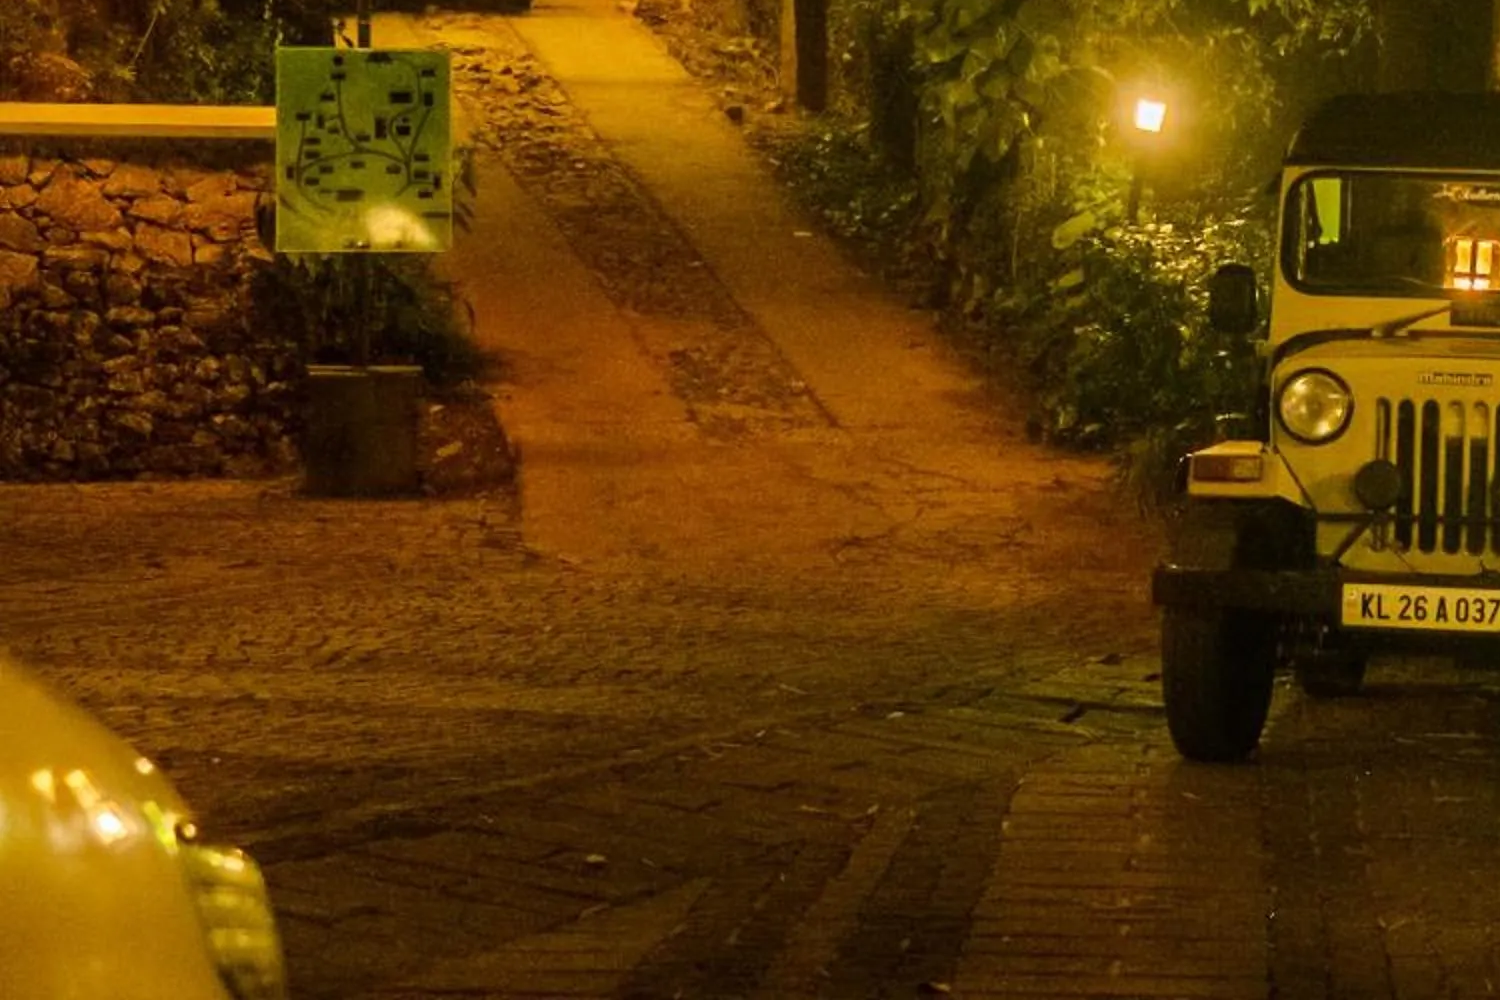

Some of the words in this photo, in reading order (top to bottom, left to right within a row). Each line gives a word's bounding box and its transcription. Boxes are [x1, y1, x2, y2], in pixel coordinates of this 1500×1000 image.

[1361, 593, 1390, 619] KL
[1398, 595, 1428, 621] 26
[1436, 596, 1449, 623] A
